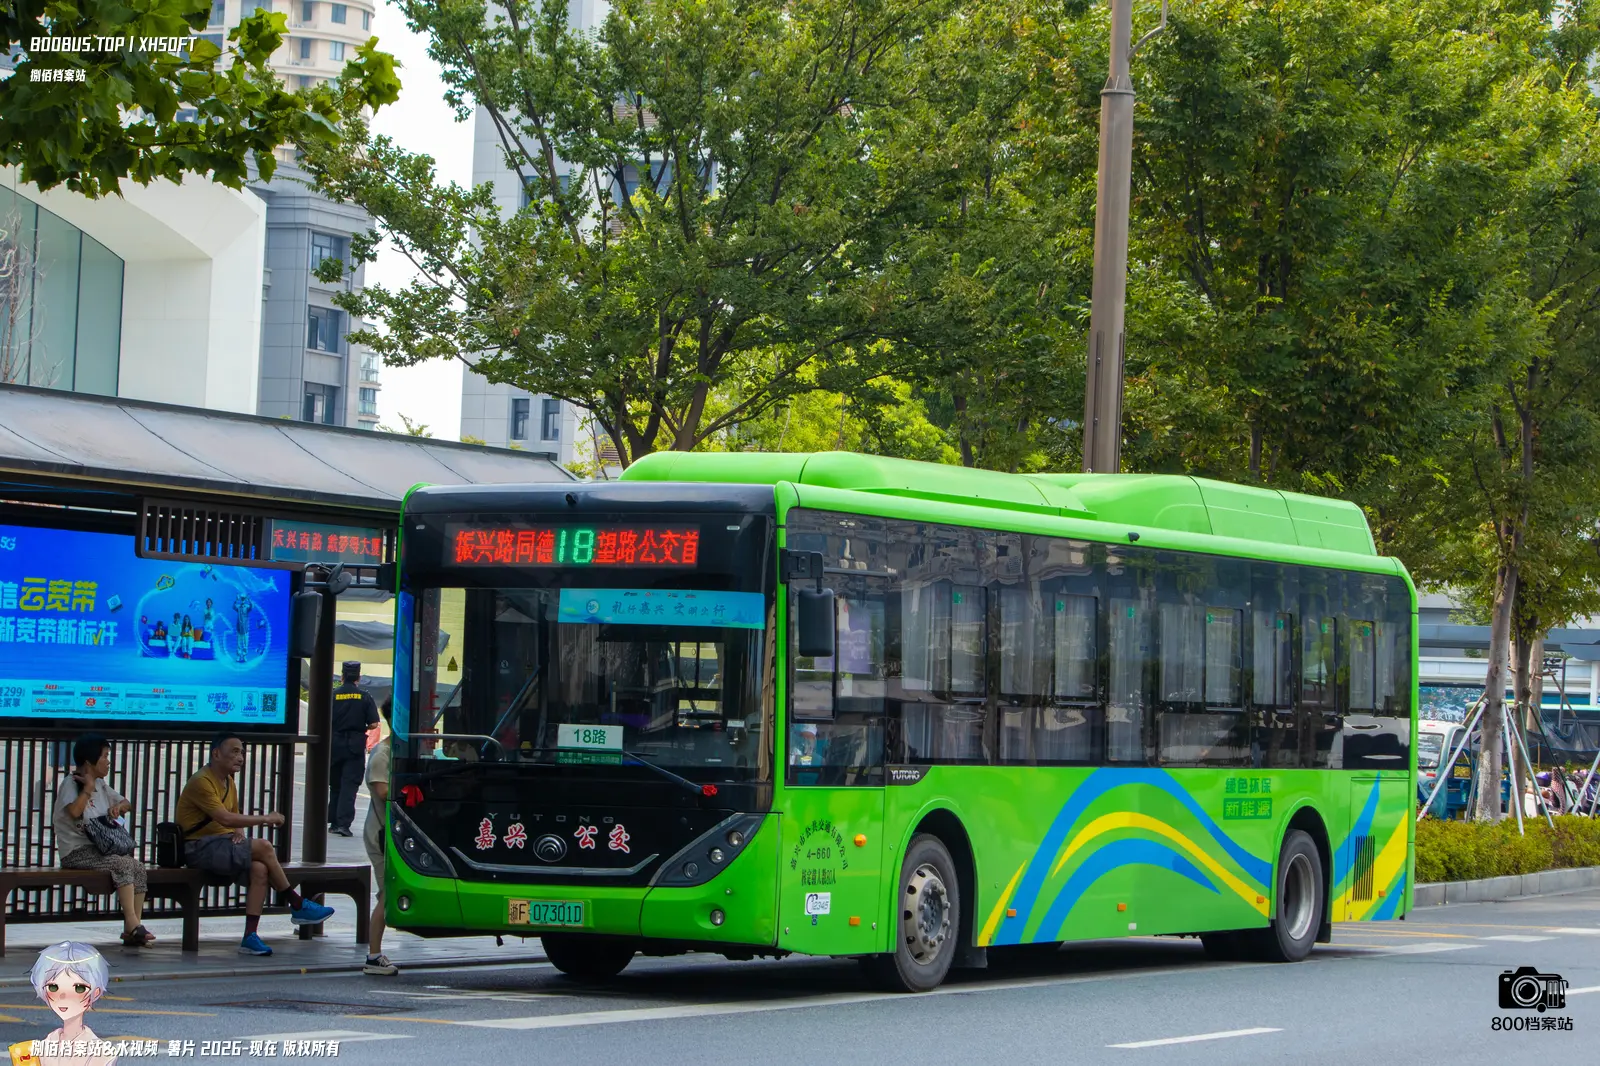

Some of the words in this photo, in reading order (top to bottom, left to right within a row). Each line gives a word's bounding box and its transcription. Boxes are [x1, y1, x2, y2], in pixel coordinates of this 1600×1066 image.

[558, 529, 595, 563] 18
[573, 728, 606, 744] 18路
[890, 769, 920, 780] YUTONG
[1225, 800, 1271, 817] 新能源
[488, 812, 615, 824] YUTONG
[474, 817, 528, 850] 嘉兴
[573, 823, 630, 853] 公交
[806, 846, 831, 860] 4-660
